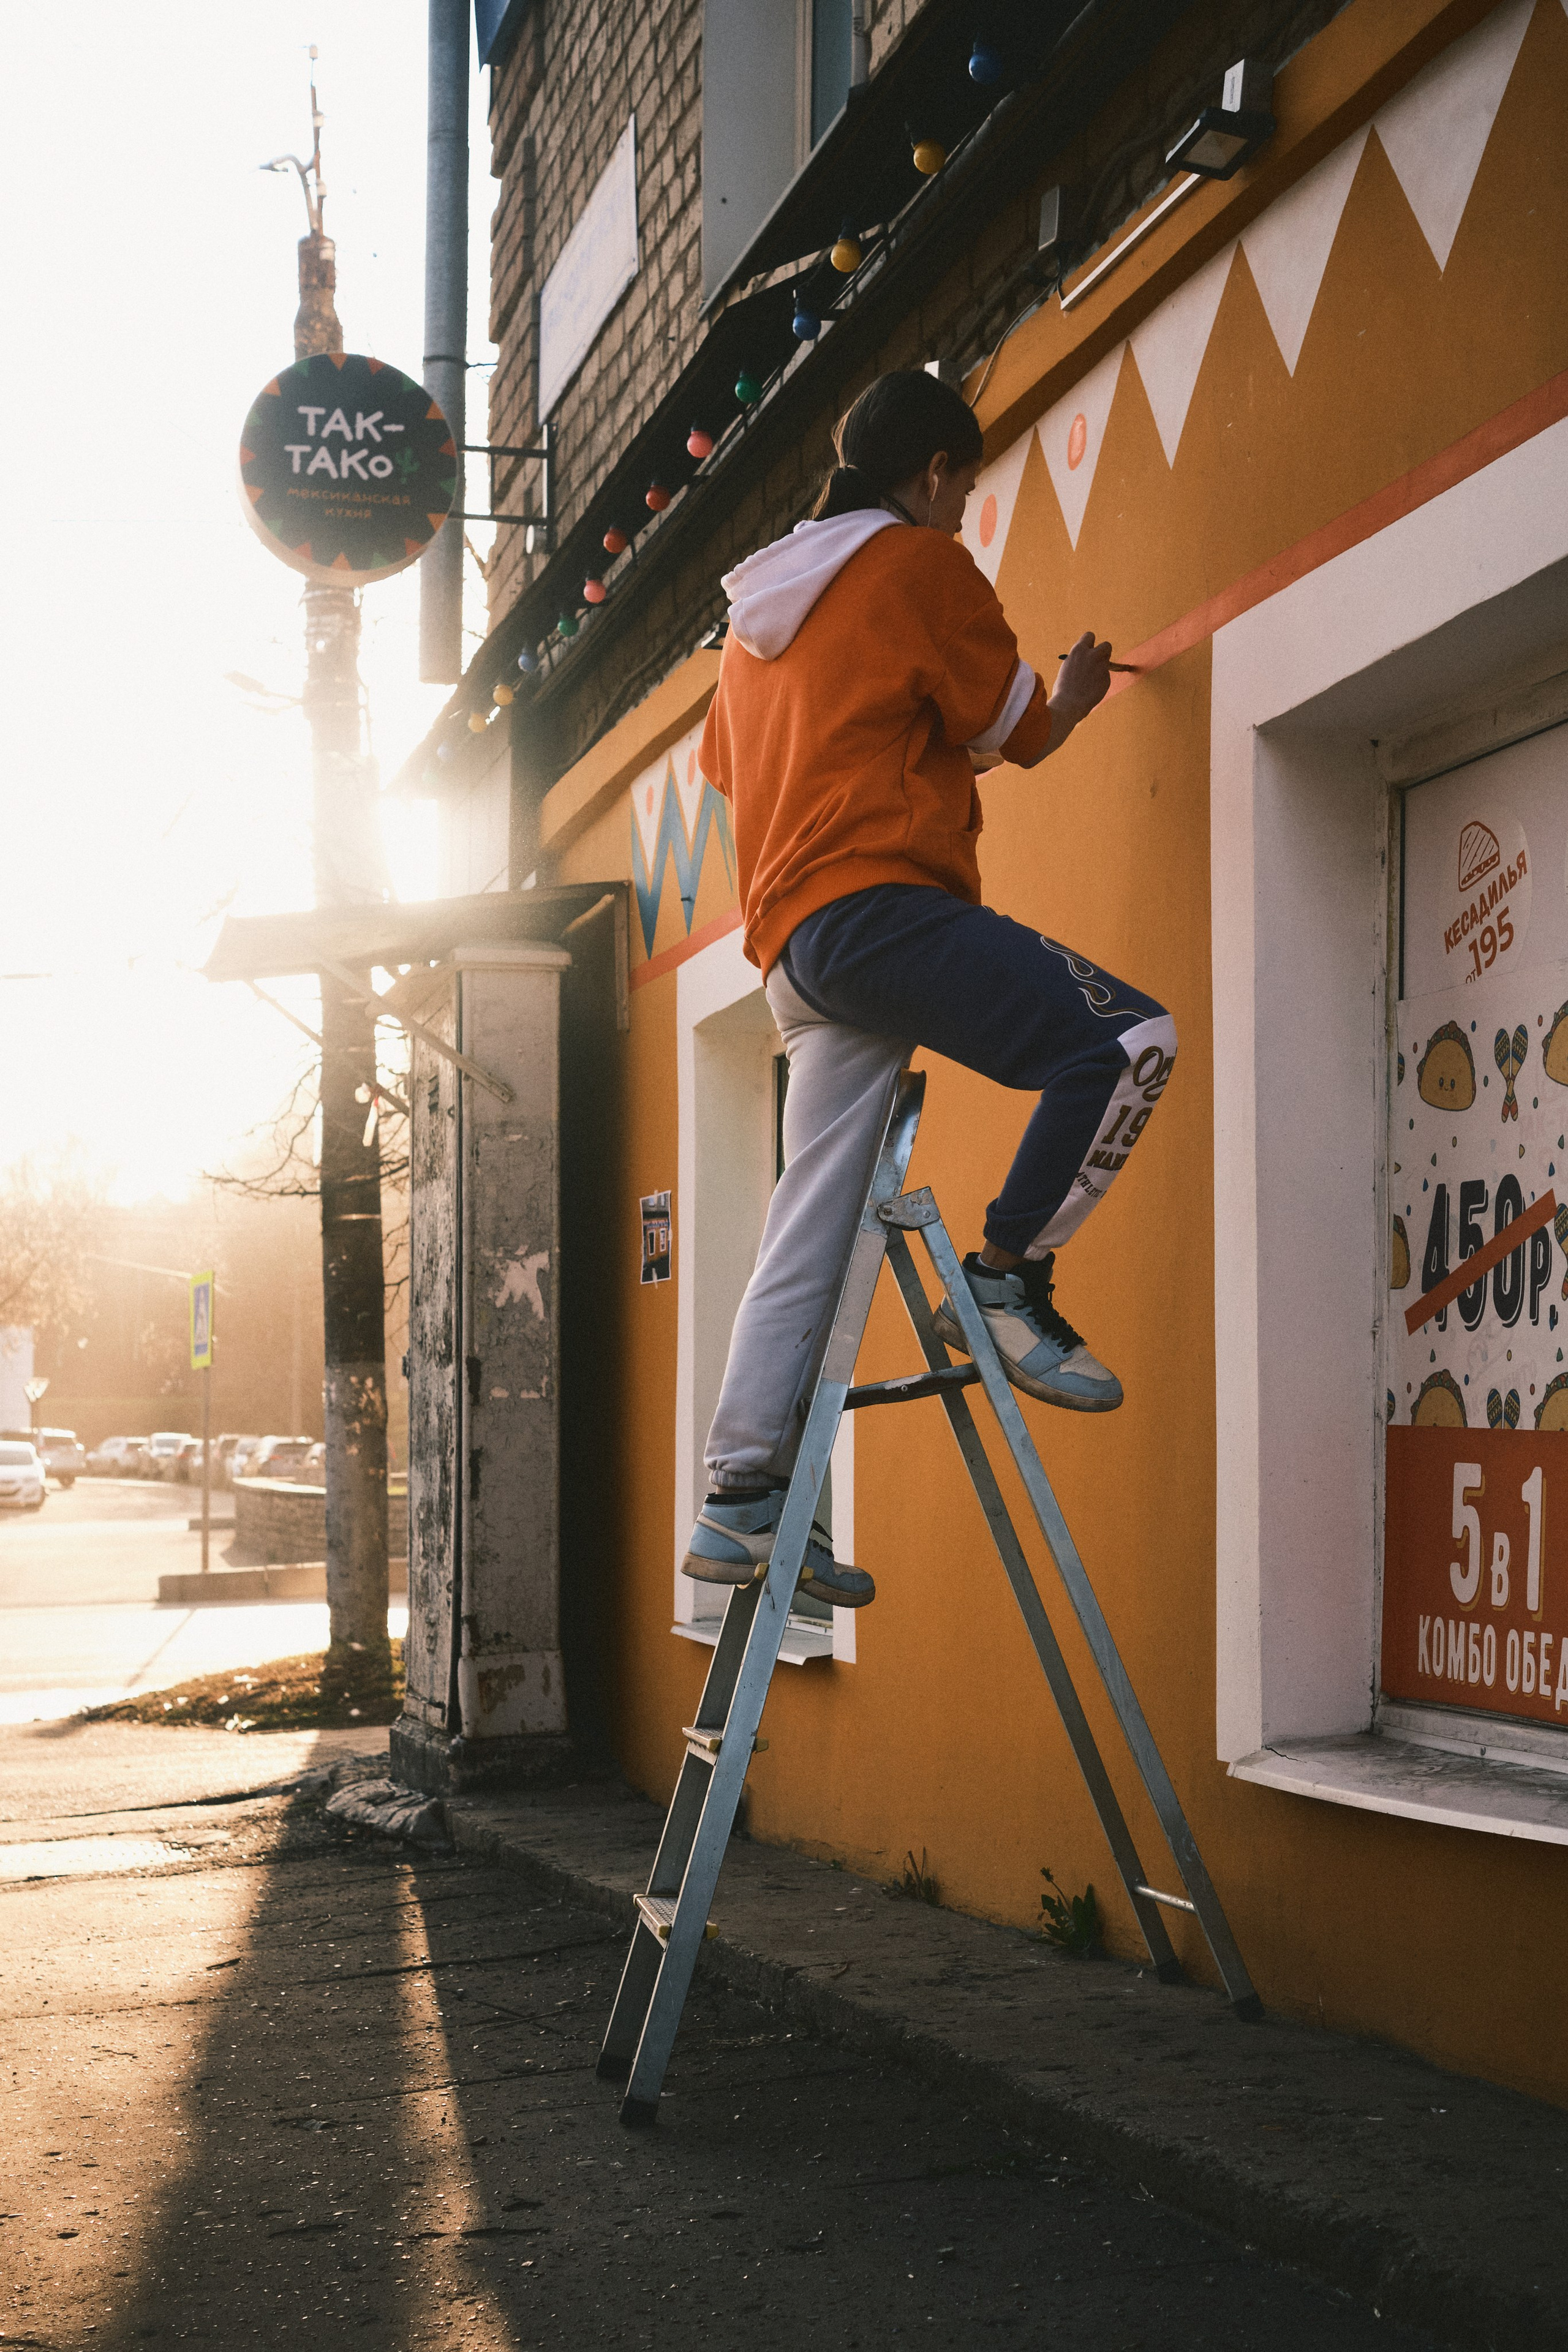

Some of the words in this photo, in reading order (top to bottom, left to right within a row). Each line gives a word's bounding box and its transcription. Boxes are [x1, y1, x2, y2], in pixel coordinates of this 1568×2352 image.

[1444, 850, 1528, 954] КЕСАДИЛЬЯ
[1468, 906, 1514, 978] 195
[1450, 1462, 1485, 1610] 5
[1521, 1466, 1547, 1620] 1
[1417, 1615, 1497, 1688] КОМБО
